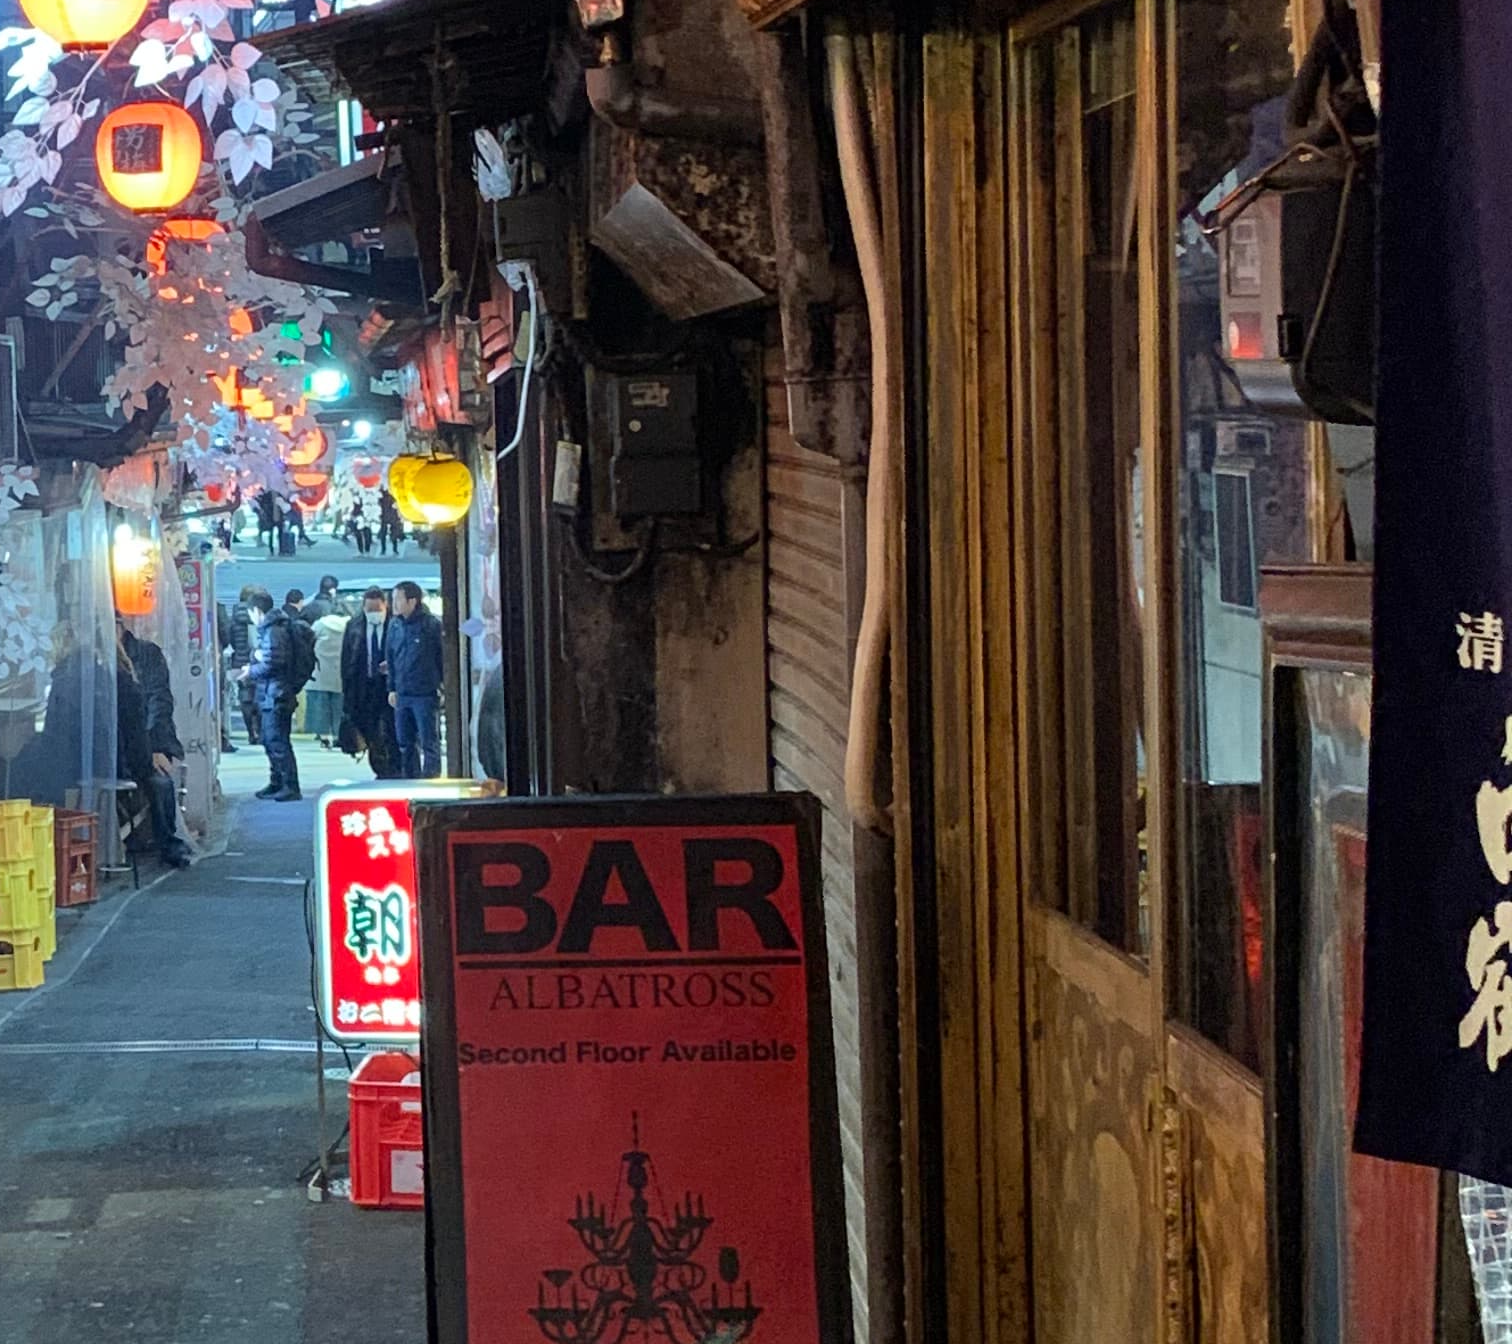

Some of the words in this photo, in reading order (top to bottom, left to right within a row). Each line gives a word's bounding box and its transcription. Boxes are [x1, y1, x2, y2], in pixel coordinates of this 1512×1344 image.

[346, 884, 408, 963] 朝
[452, 836, 800, 954] BAR
[490, 970, 776, 1010] ALBATROSS
[458, 1041, 567, 1066] Second
[576, 1041, 651, 1064] Floor
[662, 1038, 797, 1063] Available
